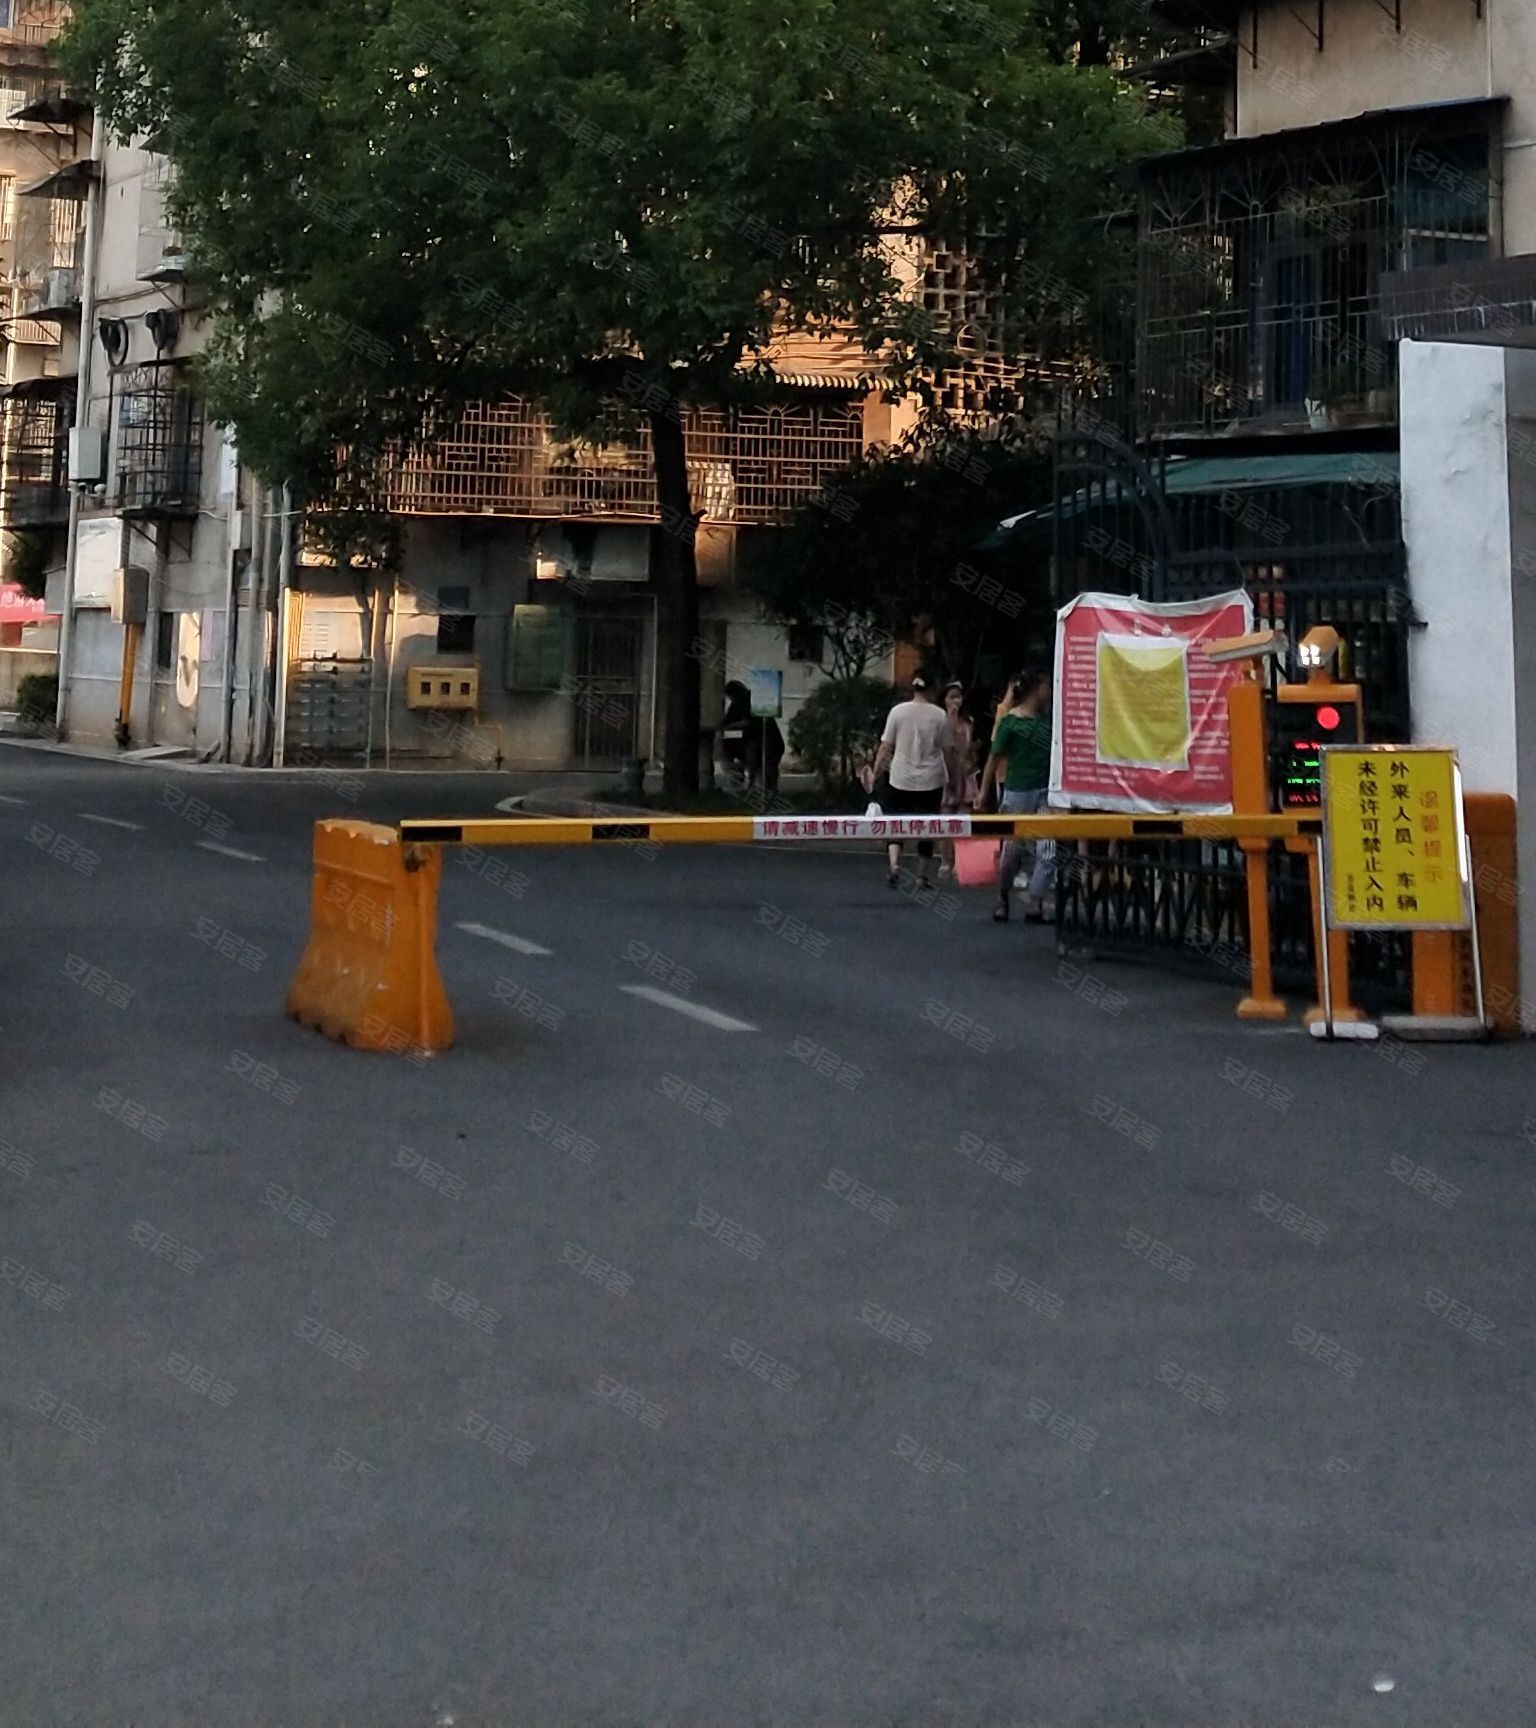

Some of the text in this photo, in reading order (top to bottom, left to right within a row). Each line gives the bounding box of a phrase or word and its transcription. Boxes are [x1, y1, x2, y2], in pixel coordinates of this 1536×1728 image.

[1358, 761, 1384, 913] 未经许可禁止入内
